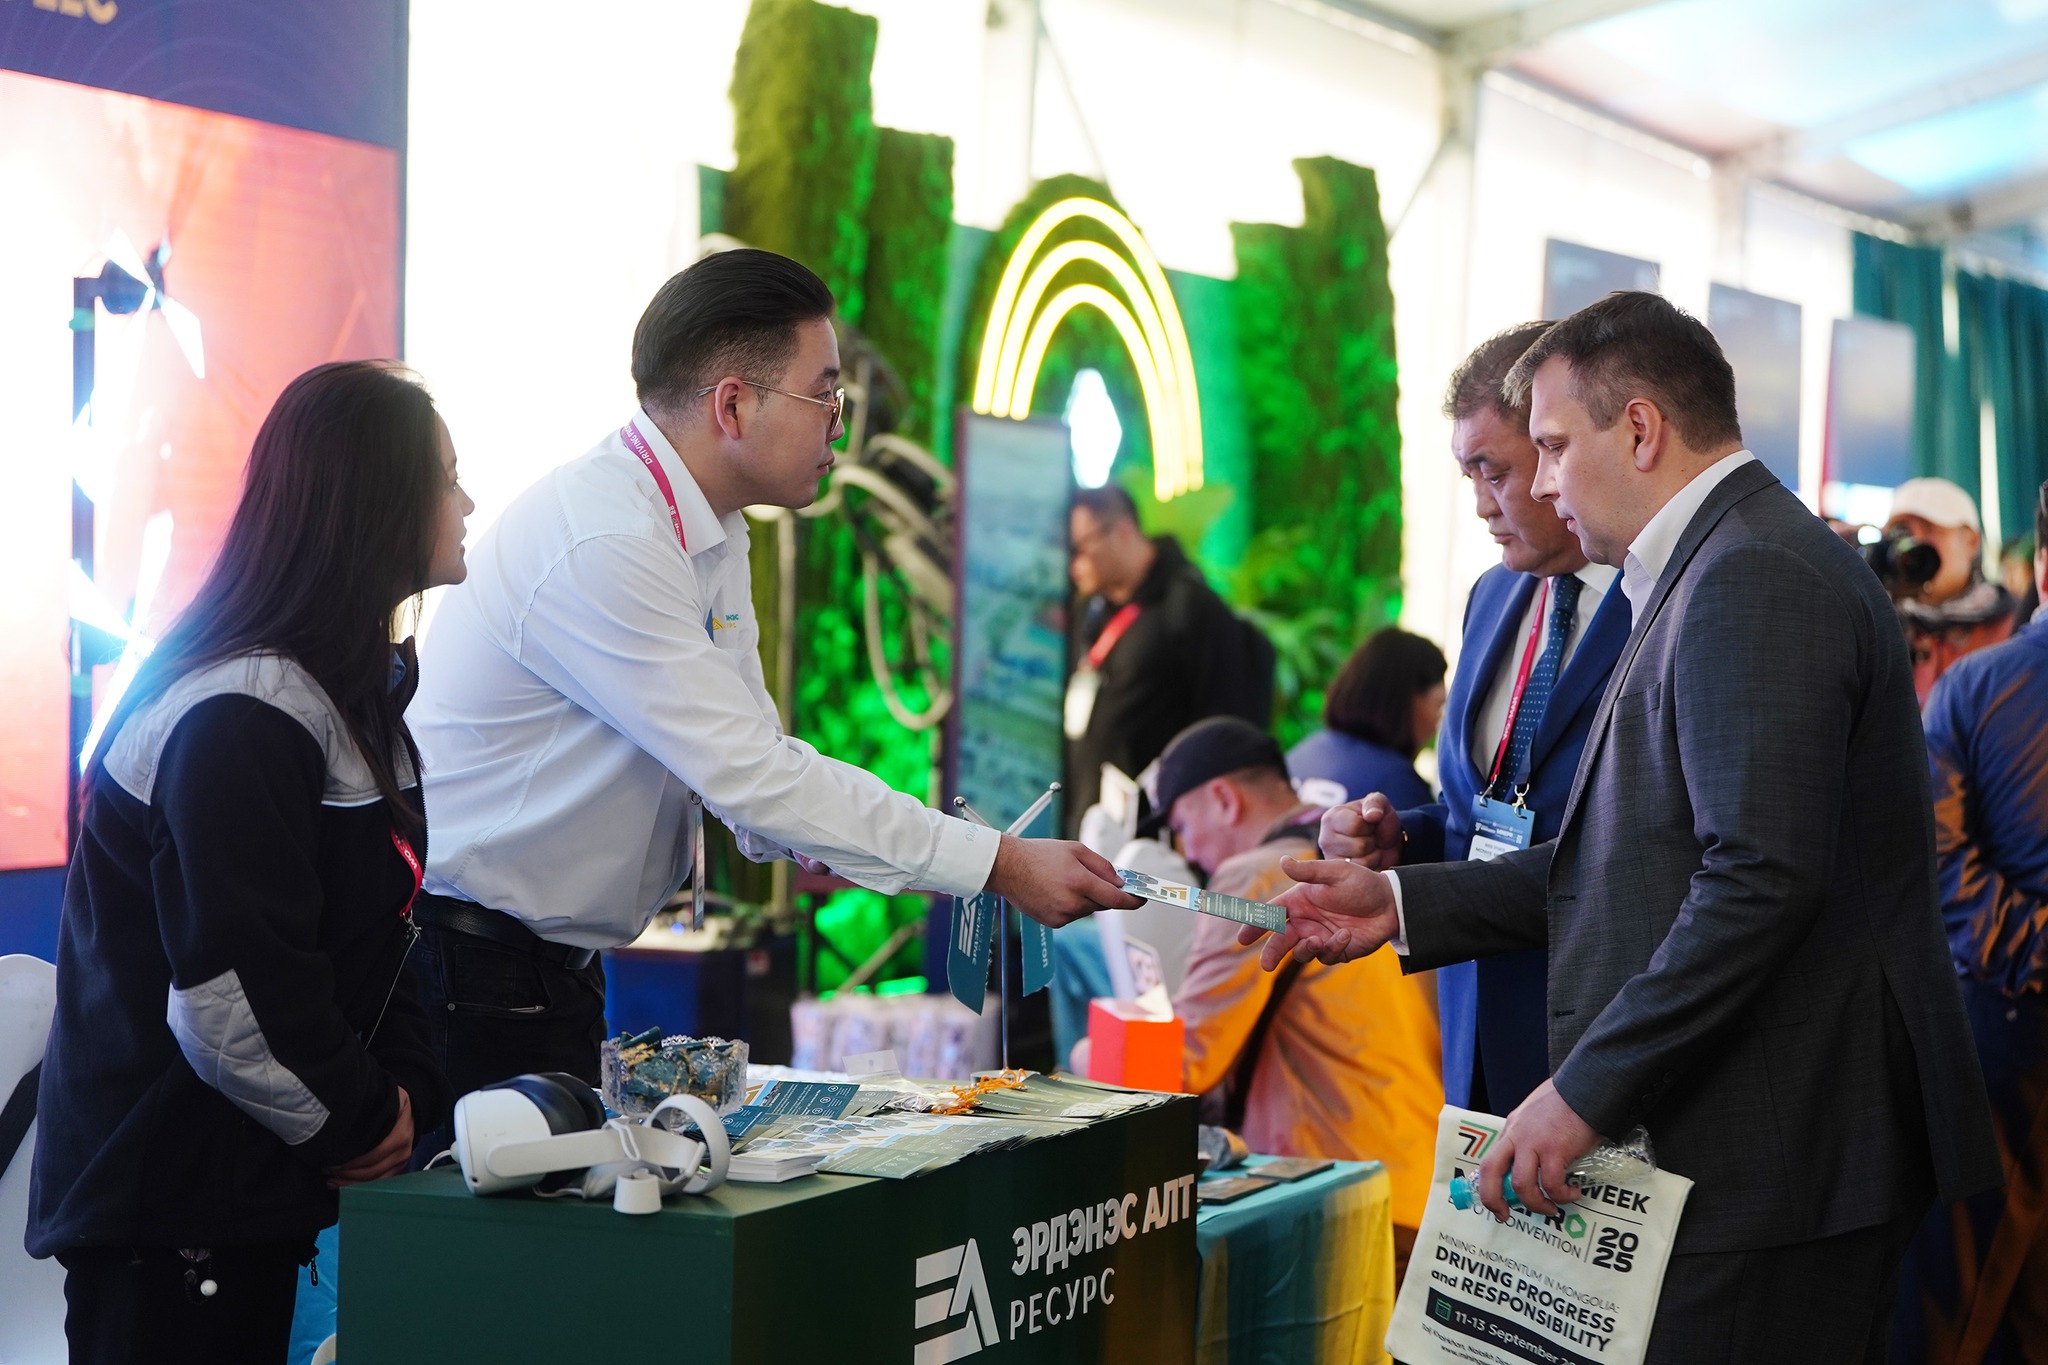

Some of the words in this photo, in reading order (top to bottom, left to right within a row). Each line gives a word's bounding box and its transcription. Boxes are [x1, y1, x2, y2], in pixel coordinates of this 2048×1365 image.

[630, 434, 653, 465] DRIVING
[1012, 1193, 1138, 1276] ЭРДЭНЭС
[1142, 1174, 1195, 1234] АЛТ
[1581, 1183, 1651, 1214] WEEK
[1592, 1247, 1634, 1273] 25
[1597, 1227, 1639, 1252] 20
[1010, 1267, 1115, 1340] РЕСУРС
[1435, 1245, 1513, 1288] DRIVING
[1516, 1279, 1616, 1333] PROGRESS
[1438, 1231, 1477, 1255] MINING
[1479, 1247, 1543, 1281] MOMENTUM
[1544, 1277, 1555, 1288] IN
[1556, 1281, 1621, 1314] MONGOLIA:
[1431, 1270, 1458, 1288] and
[1461, 1277, 1611, 1352] RESPONSIBILITY
[1454, 1310, 1487, 1332] 11-13
[1488, 1323, 1559, 1364] September
